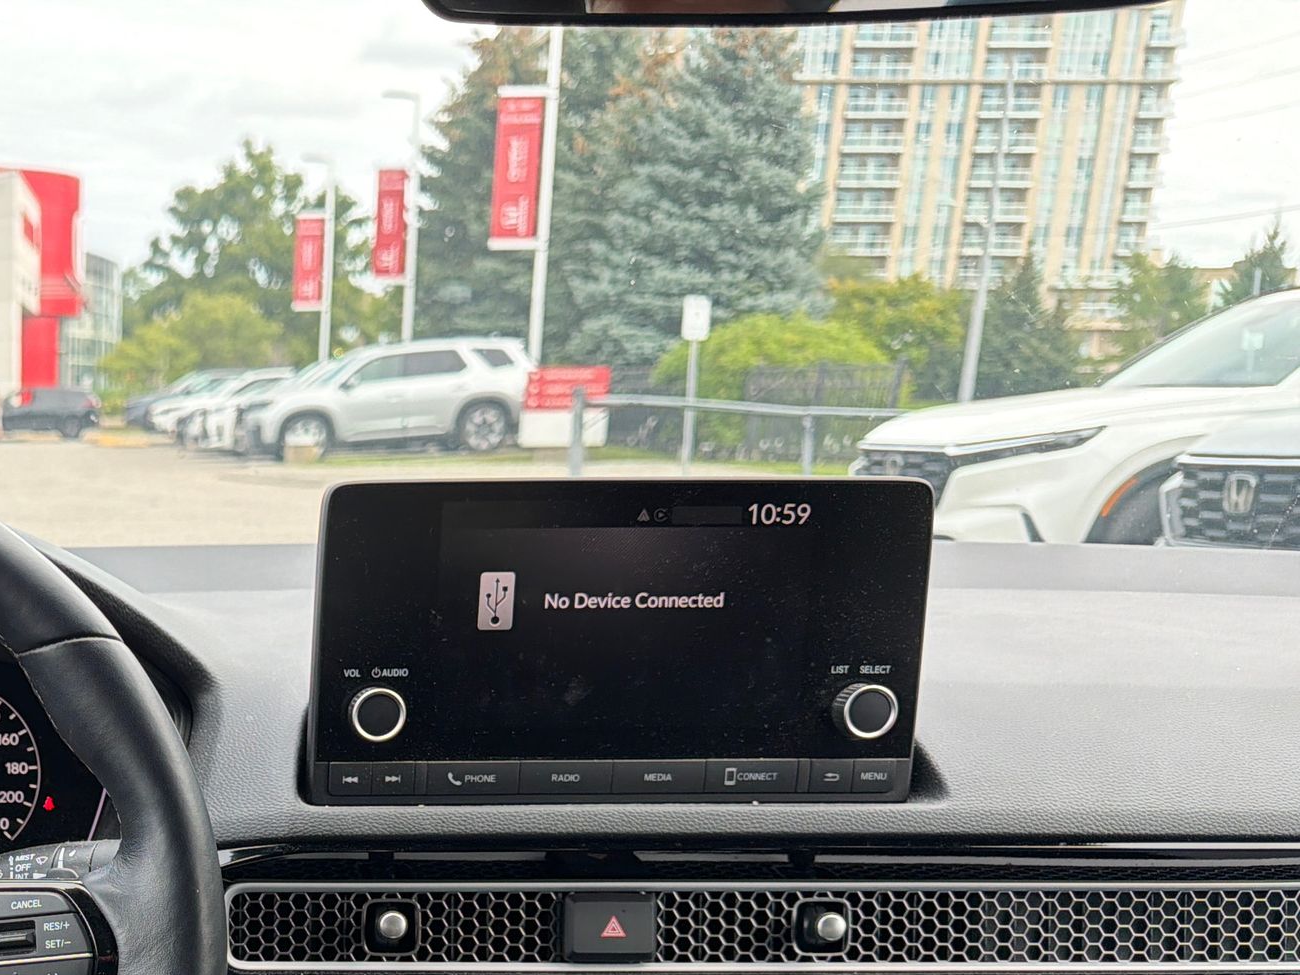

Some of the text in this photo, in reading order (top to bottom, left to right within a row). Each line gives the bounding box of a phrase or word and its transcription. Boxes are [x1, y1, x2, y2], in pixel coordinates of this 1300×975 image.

[747, 502, 812, 525] 10:59
[544, 591, 726, 609] No Device Connected
[343, 668, 361, 678] VOL
[381, 668, 409, 677] AUDIO
[830, 664, 850, 674] LIST
[859, 664, 892, 674] SELECT
[4, 761, 29, 775] 180
[464, 773, 497, 783] PHONE
[551, 773, 580, 783] RADIO
[643, 772, 673, 782] MEDIA
[736, 772, 778, 781] CONNECT
[860, 771, 888, 781] MENU
[15, 853, 36, 862] MIST
[15, 863, 32, 872] OFF
[10, 899, 42, 910] CANCEL
[43, 921, 71, 931] RES/+
